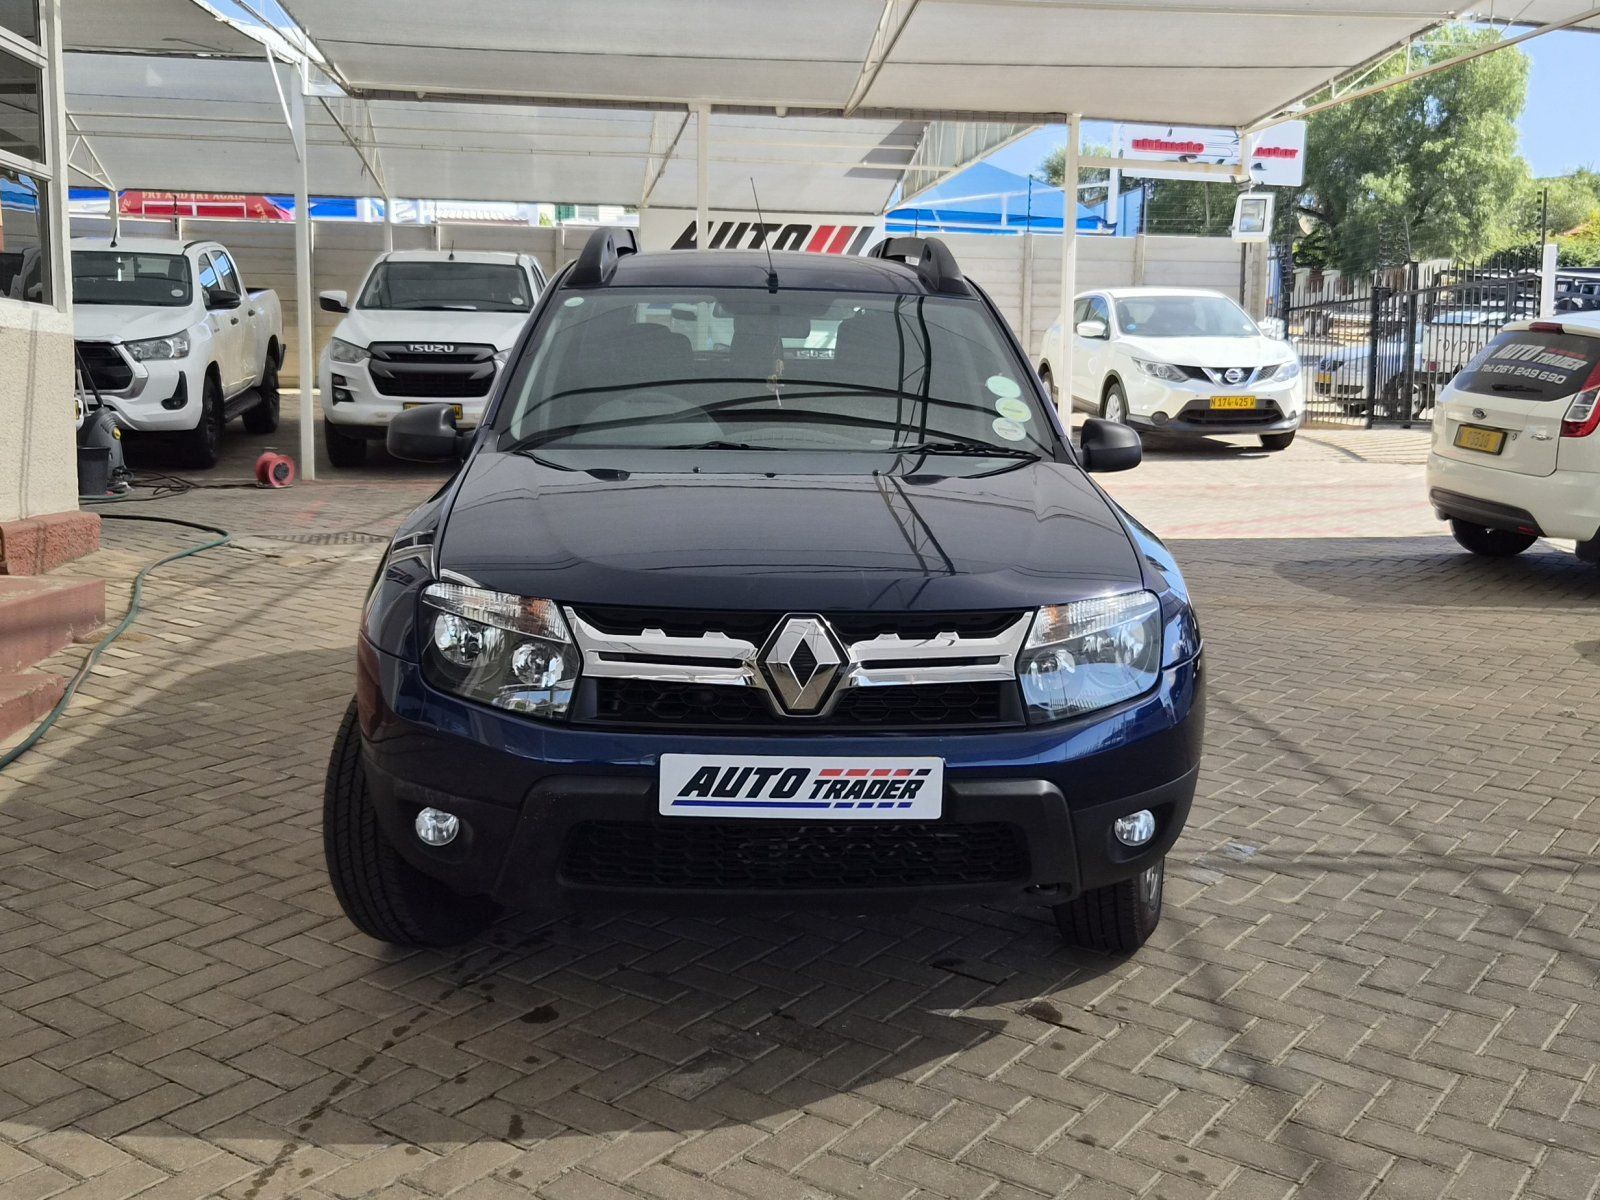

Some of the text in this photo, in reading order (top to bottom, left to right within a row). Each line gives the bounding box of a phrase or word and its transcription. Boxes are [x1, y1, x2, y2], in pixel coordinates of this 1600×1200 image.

[409, 344, 454, 352] ISUZU
[1436, 339, 1484, 353] OYOTA
[1492, 344, 1588, 371] AUTO TRADER
[1493, 364, 1513, 374] 061
[1513, 366, 1540, 379] 249
[1538, 372, 1567, 385] 690
[677, 766, 925, 800] AUTO TRADER
